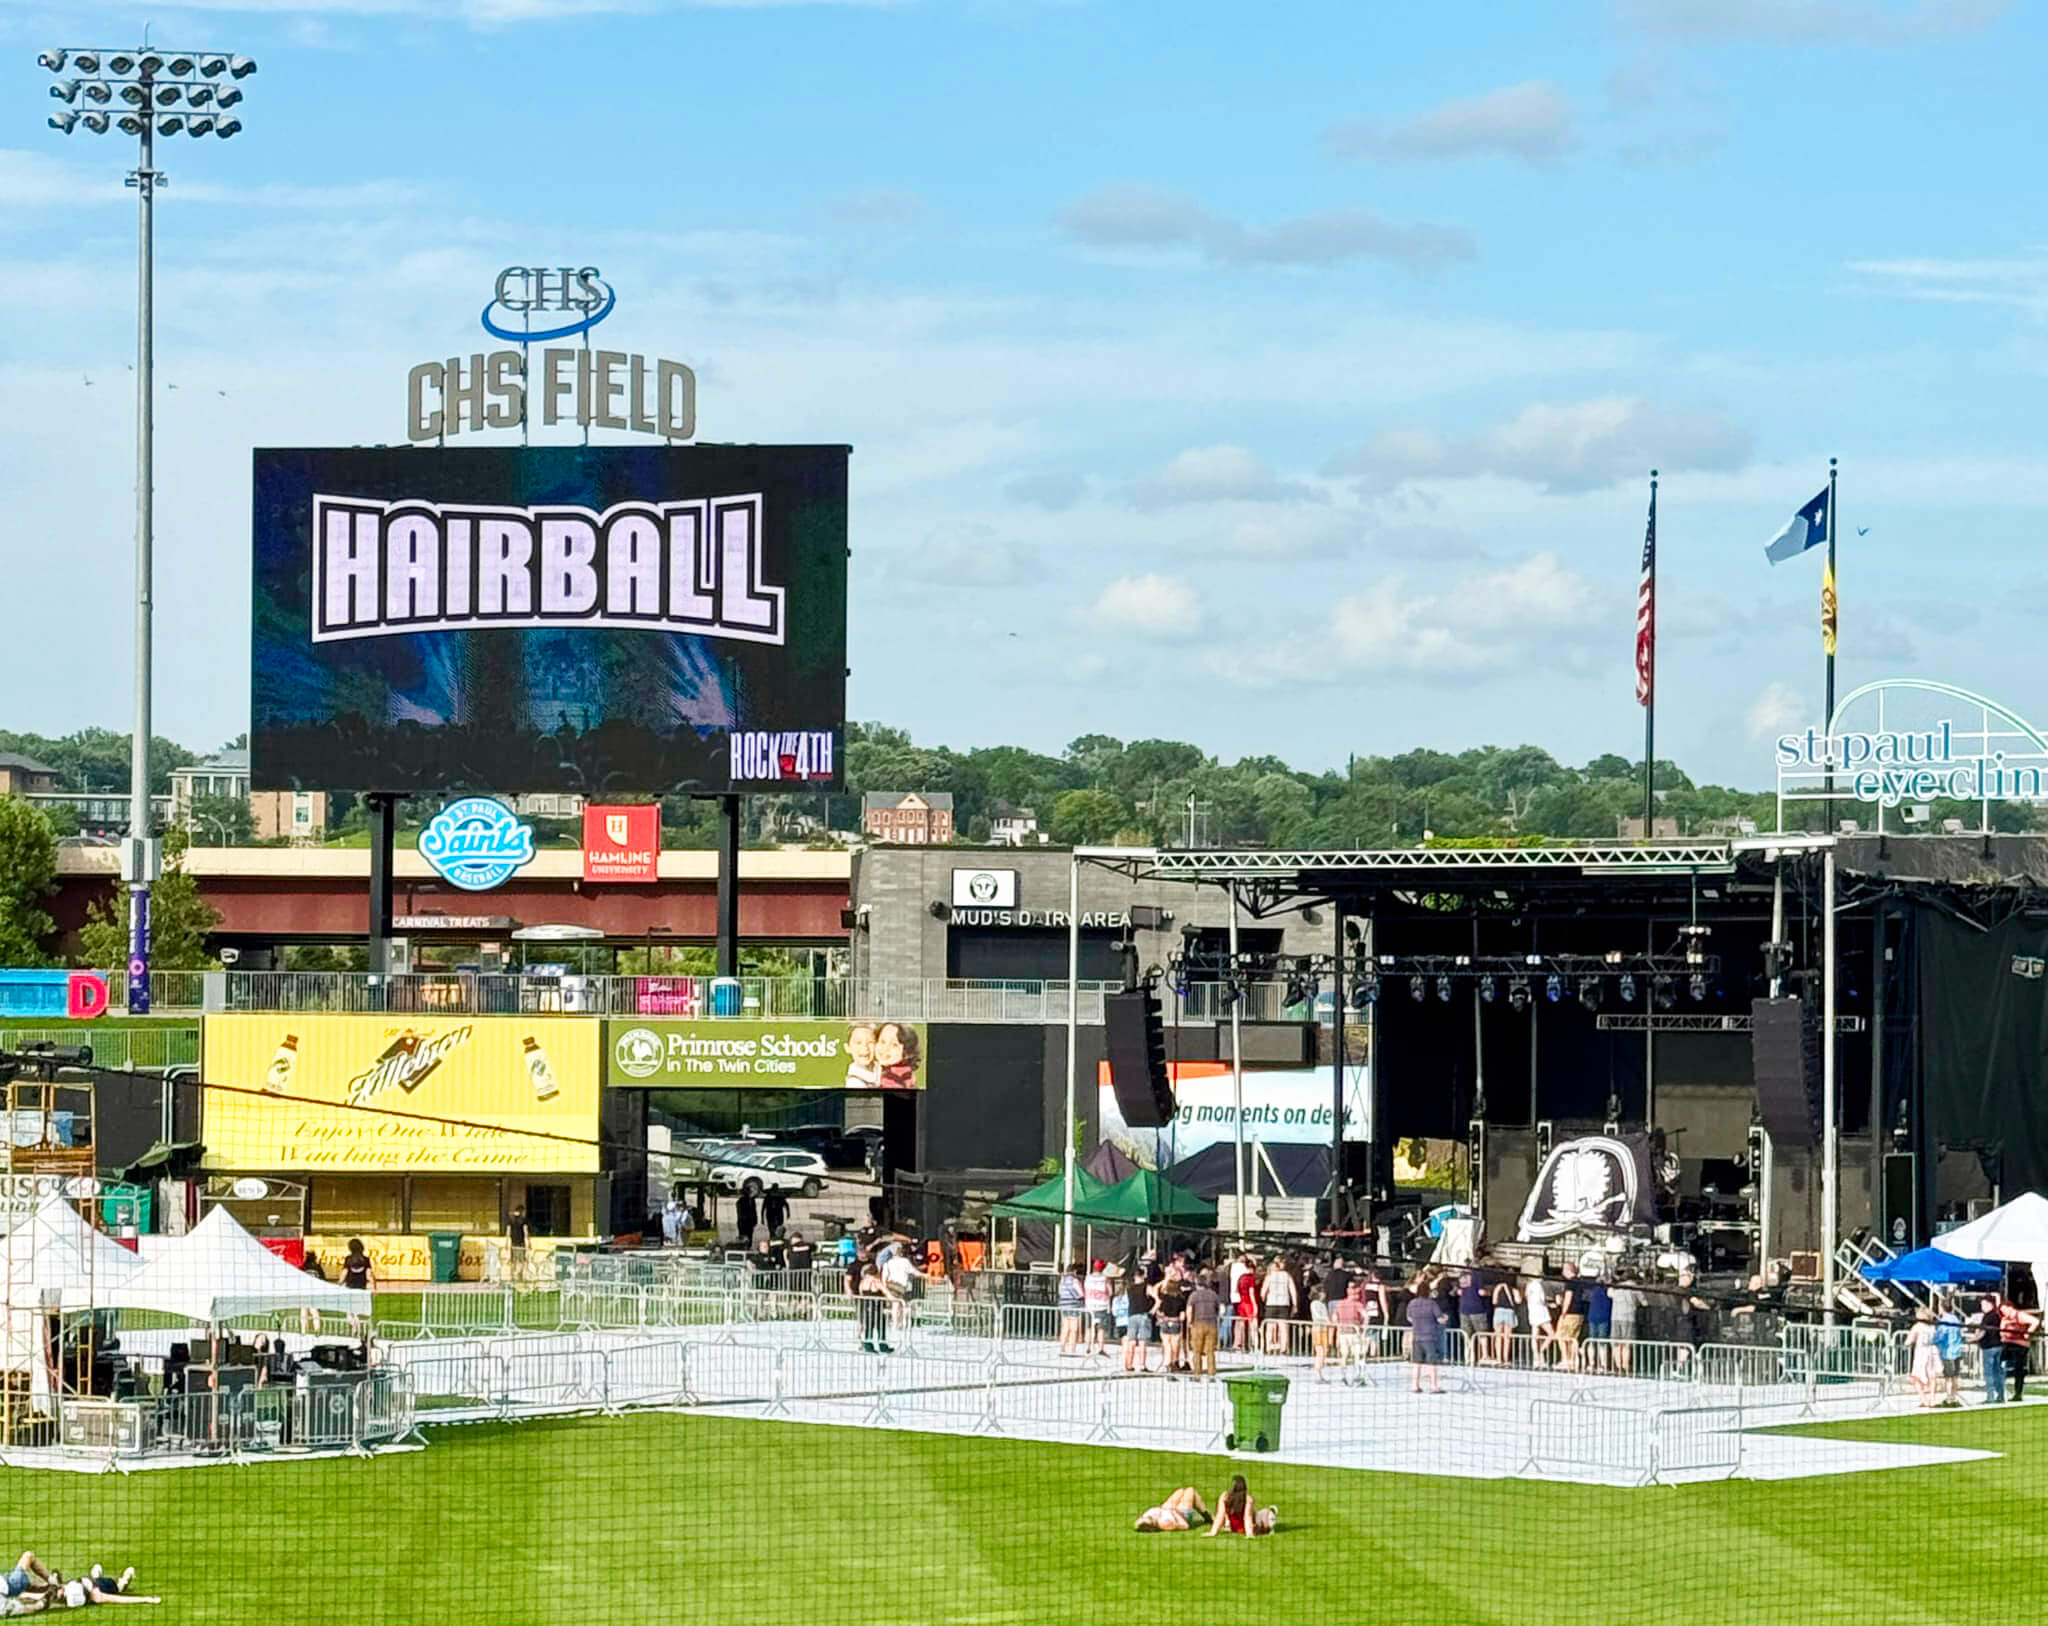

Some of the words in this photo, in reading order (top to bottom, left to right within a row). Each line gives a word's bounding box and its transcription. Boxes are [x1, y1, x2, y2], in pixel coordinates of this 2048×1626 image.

[494, 266, 603, 311] CHS
[407, 350, 524, 441] CHS
[543, 348, 697, 440] FIELD
[314, 496, 783, 643] HAIRBALL
[730, 731, 781, 780] ROCK
[795, 731, 833, 780] 4TH
[1841, 720, 1952, 770] paul
[1854, 769, 1941, 806] eye
[420, 816, 534, 856] Saints
[588, 851, 651, 865] HAMLINE
[453, 863, 505, 885] BASEBALL
[392, 916, 446, 928] CARNIVAL
[448, 916, 490, 928] TREATS
[951, 910, 1012, 926] MUD'S
[1080, 911, 1132, 927] AREA
[666, 1033, 756, 1057] Primrose
[761, 1034, 837, 1057] Schools
[685, 1058, 712, 1073] The
[717, 1058, 750, 1073] Twin
[754, 1058, 797, 1073] Cities
[1199, 1104, 1280, 1124] moments
[1284, 1107, 1306, 1124] on
[1310, 1103, 1358, 1126] dek.
[294, 1121, 365, 1140] Enjoy
[377, 1121, 432, 1137] One
[280, 1145, 399, 1165] Watching
[406, 1146, 448, 1165] the
[453, 1146, 528, 1165] Game
[367, 1249, 405, 1266] Root
